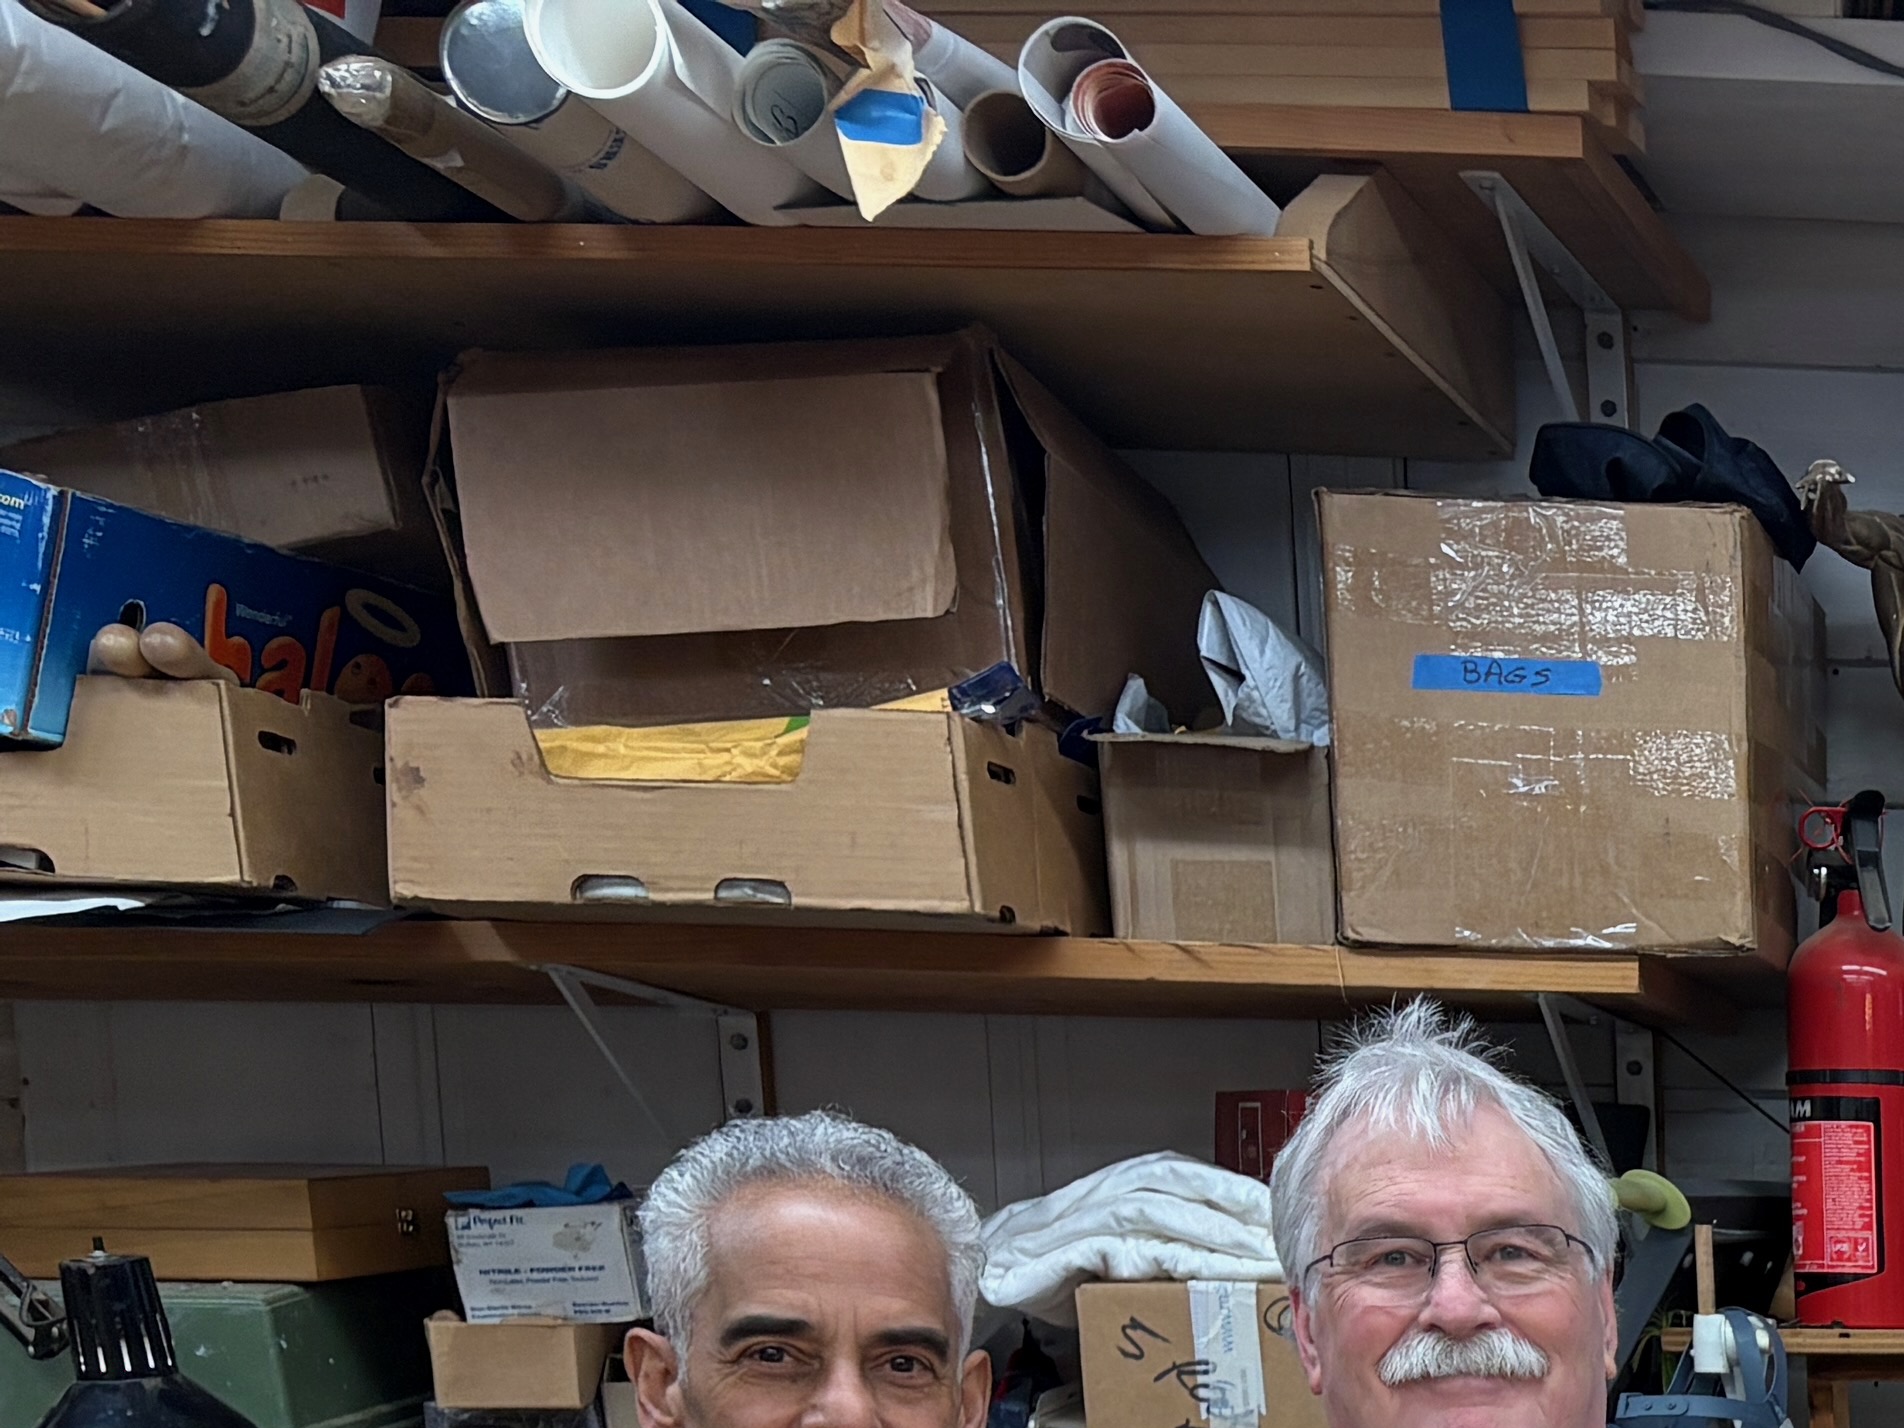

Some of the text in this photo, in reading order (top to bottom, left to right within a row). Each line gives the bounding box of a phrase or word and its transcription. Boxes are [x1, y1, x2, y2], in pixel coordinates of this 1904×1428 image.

[1460, 658, 1554, 689] BAGS
[479, 1264, 606, 1276] NITRILE POWDER FREE
